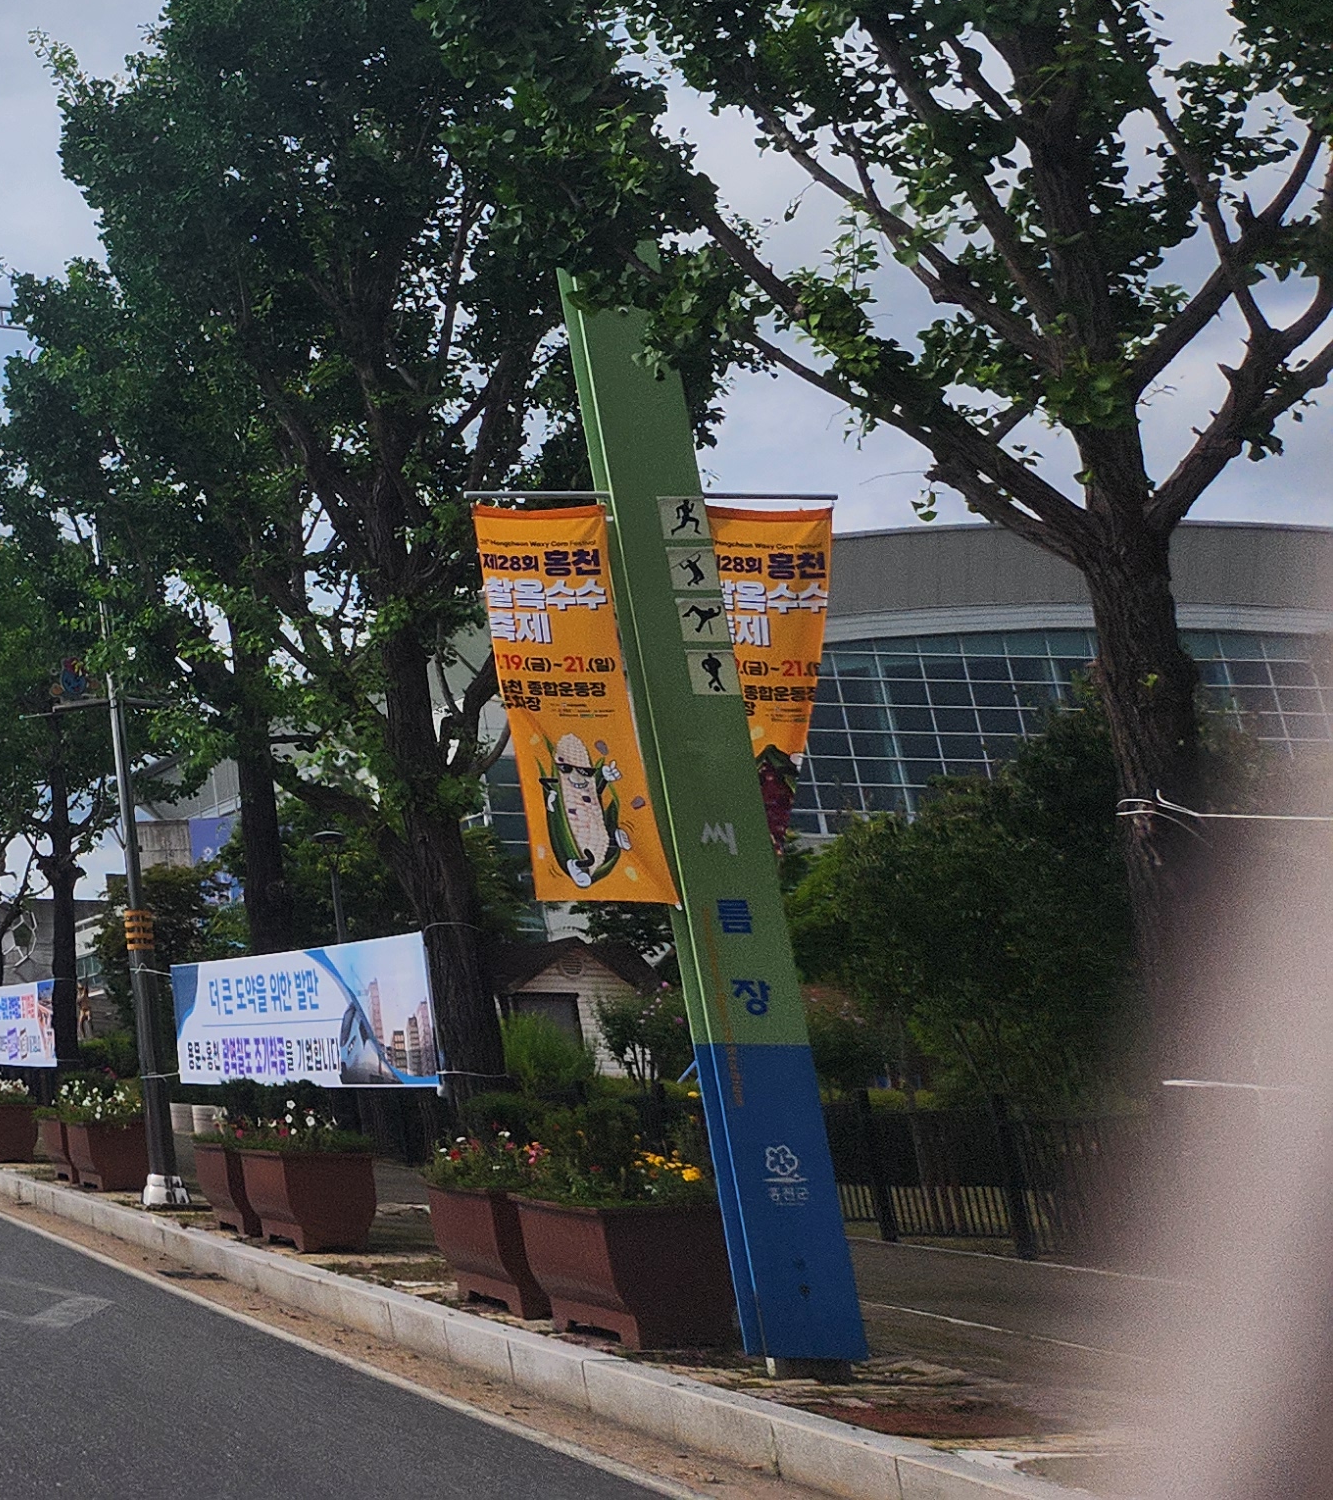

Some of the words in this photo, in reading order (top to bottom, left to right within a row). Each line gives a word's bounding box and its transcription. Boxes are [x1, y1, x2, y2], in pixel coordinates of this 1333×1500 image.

[482, 553, 539, 572] 제28회
[544, 548, 601, 576] 홍천
[767, 551, 826, 580] 홍천
[486, 576, 608, 611] 찰옥수수
[489, 610, 553, 644] 축제
[527, 680, 606, 698] 종합운동장
[208, 978, 221, 1016] 더
[221, 978, 234, 1015] 큰
[235, 973, 267, 1014] 도약을
[269, 970, 293, 1013] 위한
[293, 968, 320, 1011] 발판
[221, 1036, 252, 1075] 광역철도
[296, 1036, 341, 1072] 기원합니다
[768, 1186, 810, 1202] 홍천군
